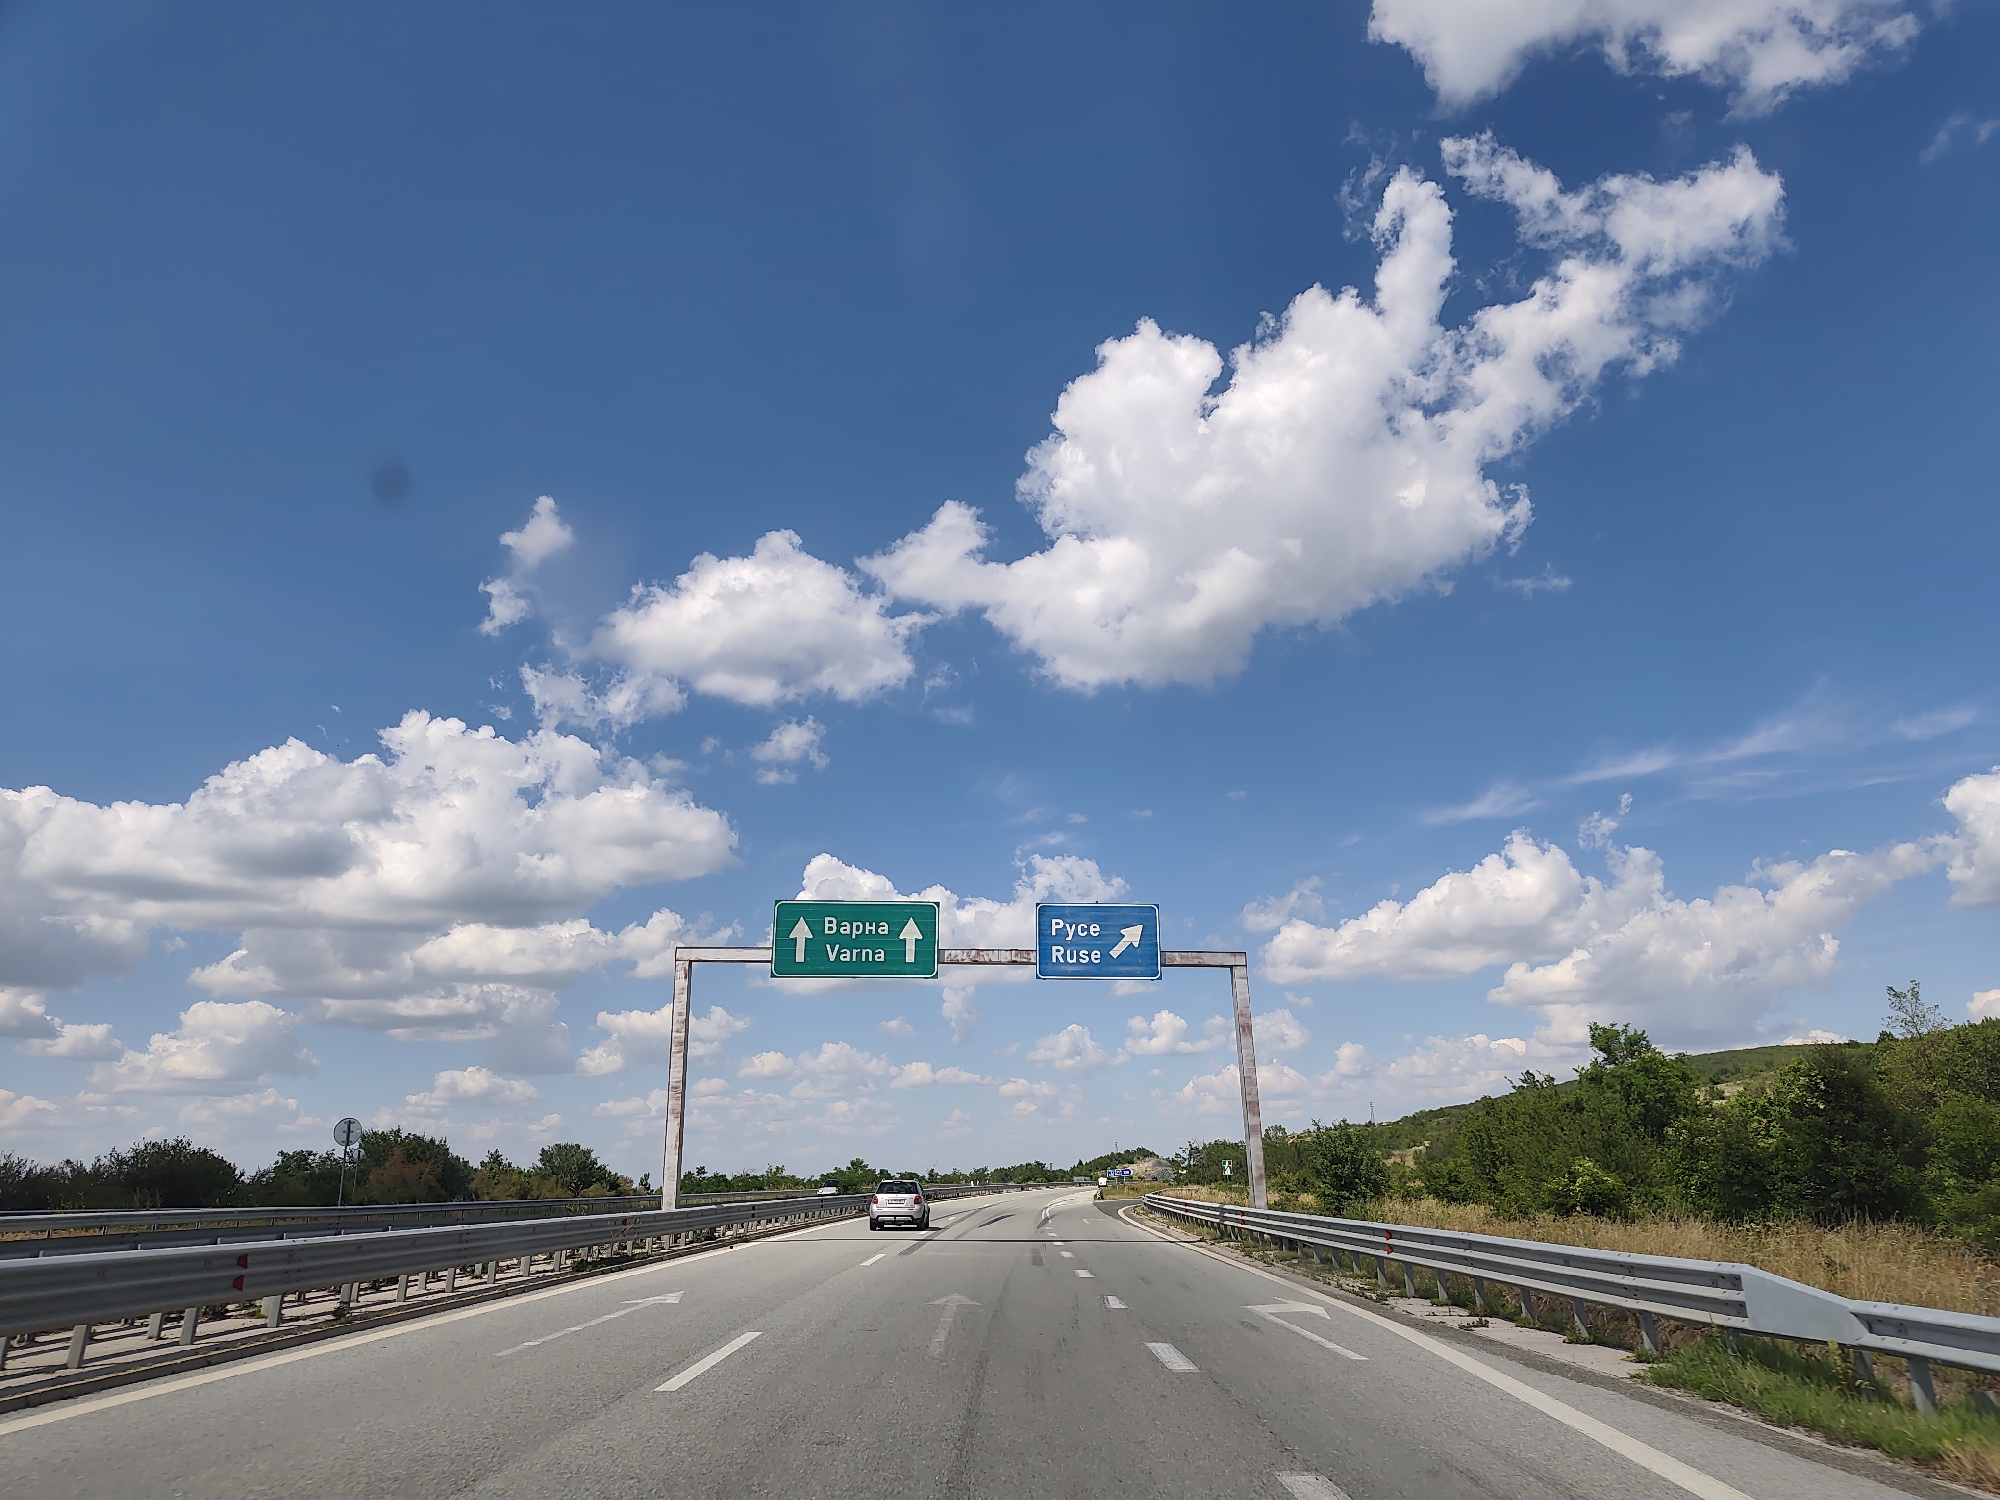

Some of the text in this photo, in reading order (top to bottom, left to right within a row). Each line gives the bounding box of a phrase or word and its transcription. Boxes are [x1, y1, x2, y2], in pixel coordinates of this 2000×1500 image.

[823, 916, 890, 938] Варна
[1050, 918, 1101, 940] Русе
[825, 943, 886, 963] Varna
[1050, 945, 1102, 964] Ruse
